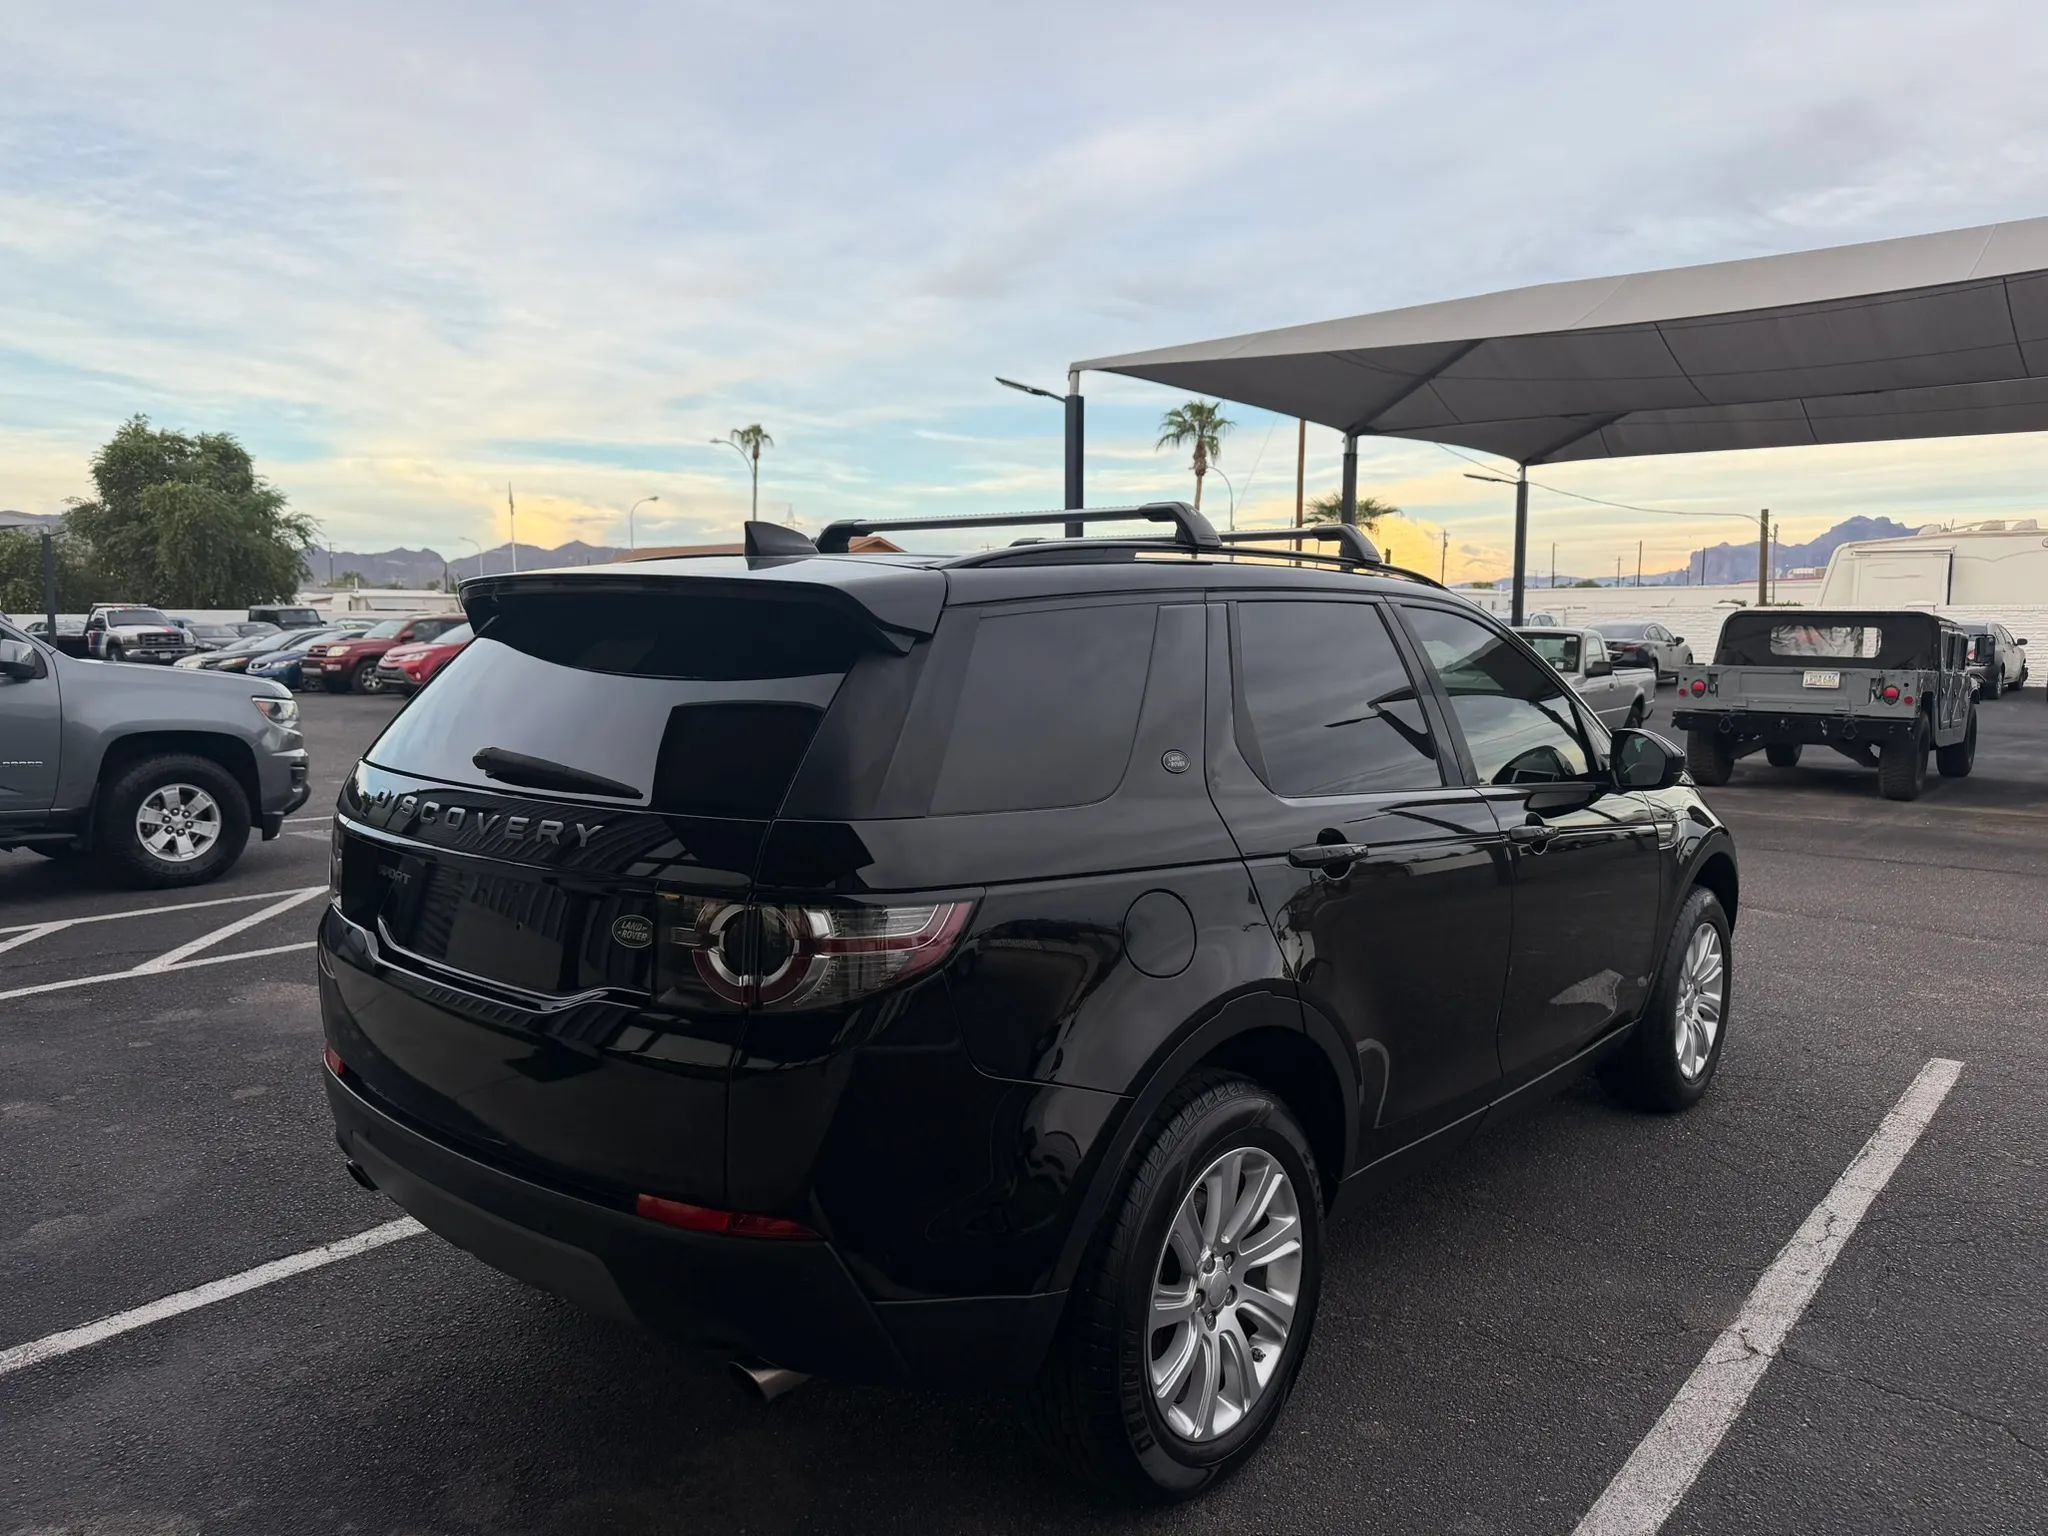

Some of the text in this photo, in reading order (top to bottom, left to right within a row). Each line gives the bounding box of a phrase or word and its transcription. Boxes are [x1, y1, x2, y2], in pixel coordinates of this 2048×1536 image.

[374, 788, 604, 848] DISCOVERY
[621, 920, 643, 932] LAND
[621, 929, 648, 942] ROVER
